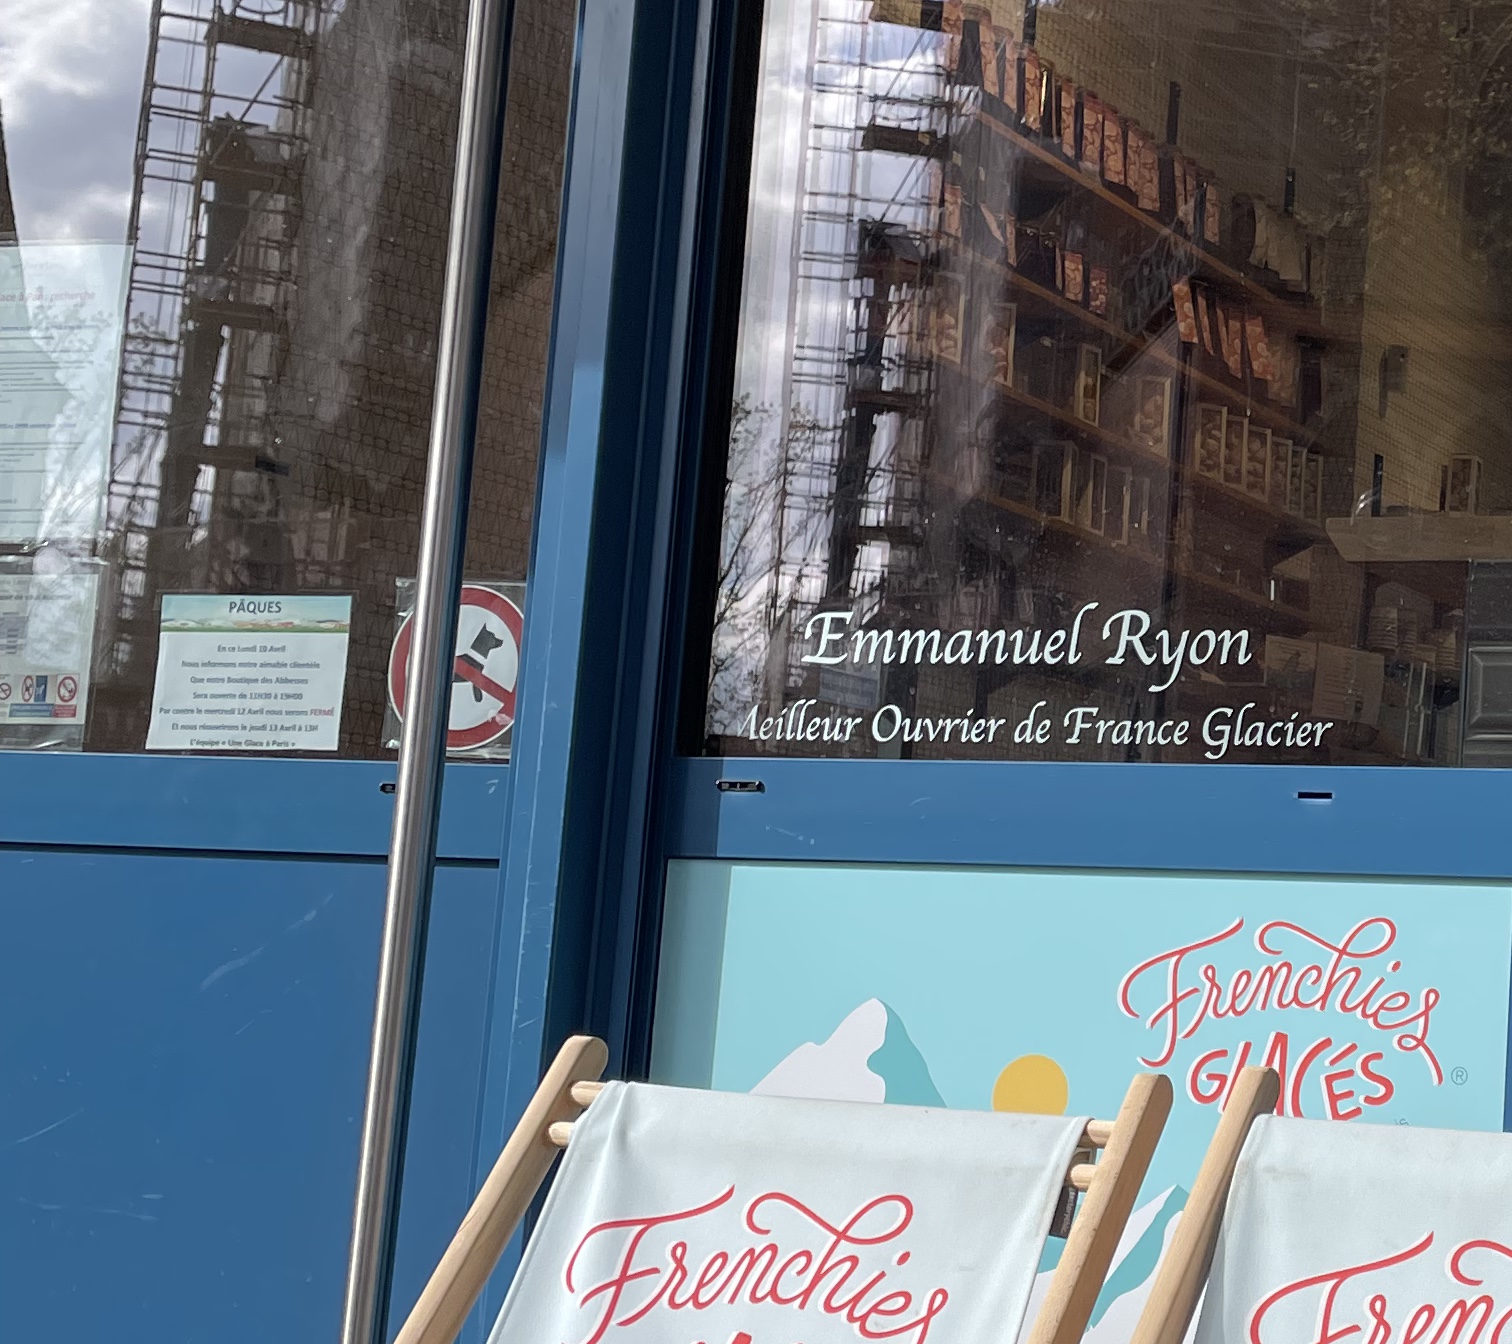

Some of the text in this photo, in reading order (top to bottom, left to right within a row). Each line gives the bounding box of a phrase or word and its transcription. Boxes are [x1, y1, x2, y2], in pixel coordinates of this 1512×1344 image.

[228, 599, 282, 615] PÂQUES
[800, 602, 1252, 693] Emmanuel Ryon
[872, 704, 1003, 744] Ouvrier
[1014, 701, 1051, 744] de
[1062, 706, 1190, 746] France
[1202, 703, 1334, 760] Glacier
[1117, 916, 1444, 1088] Frenchies
